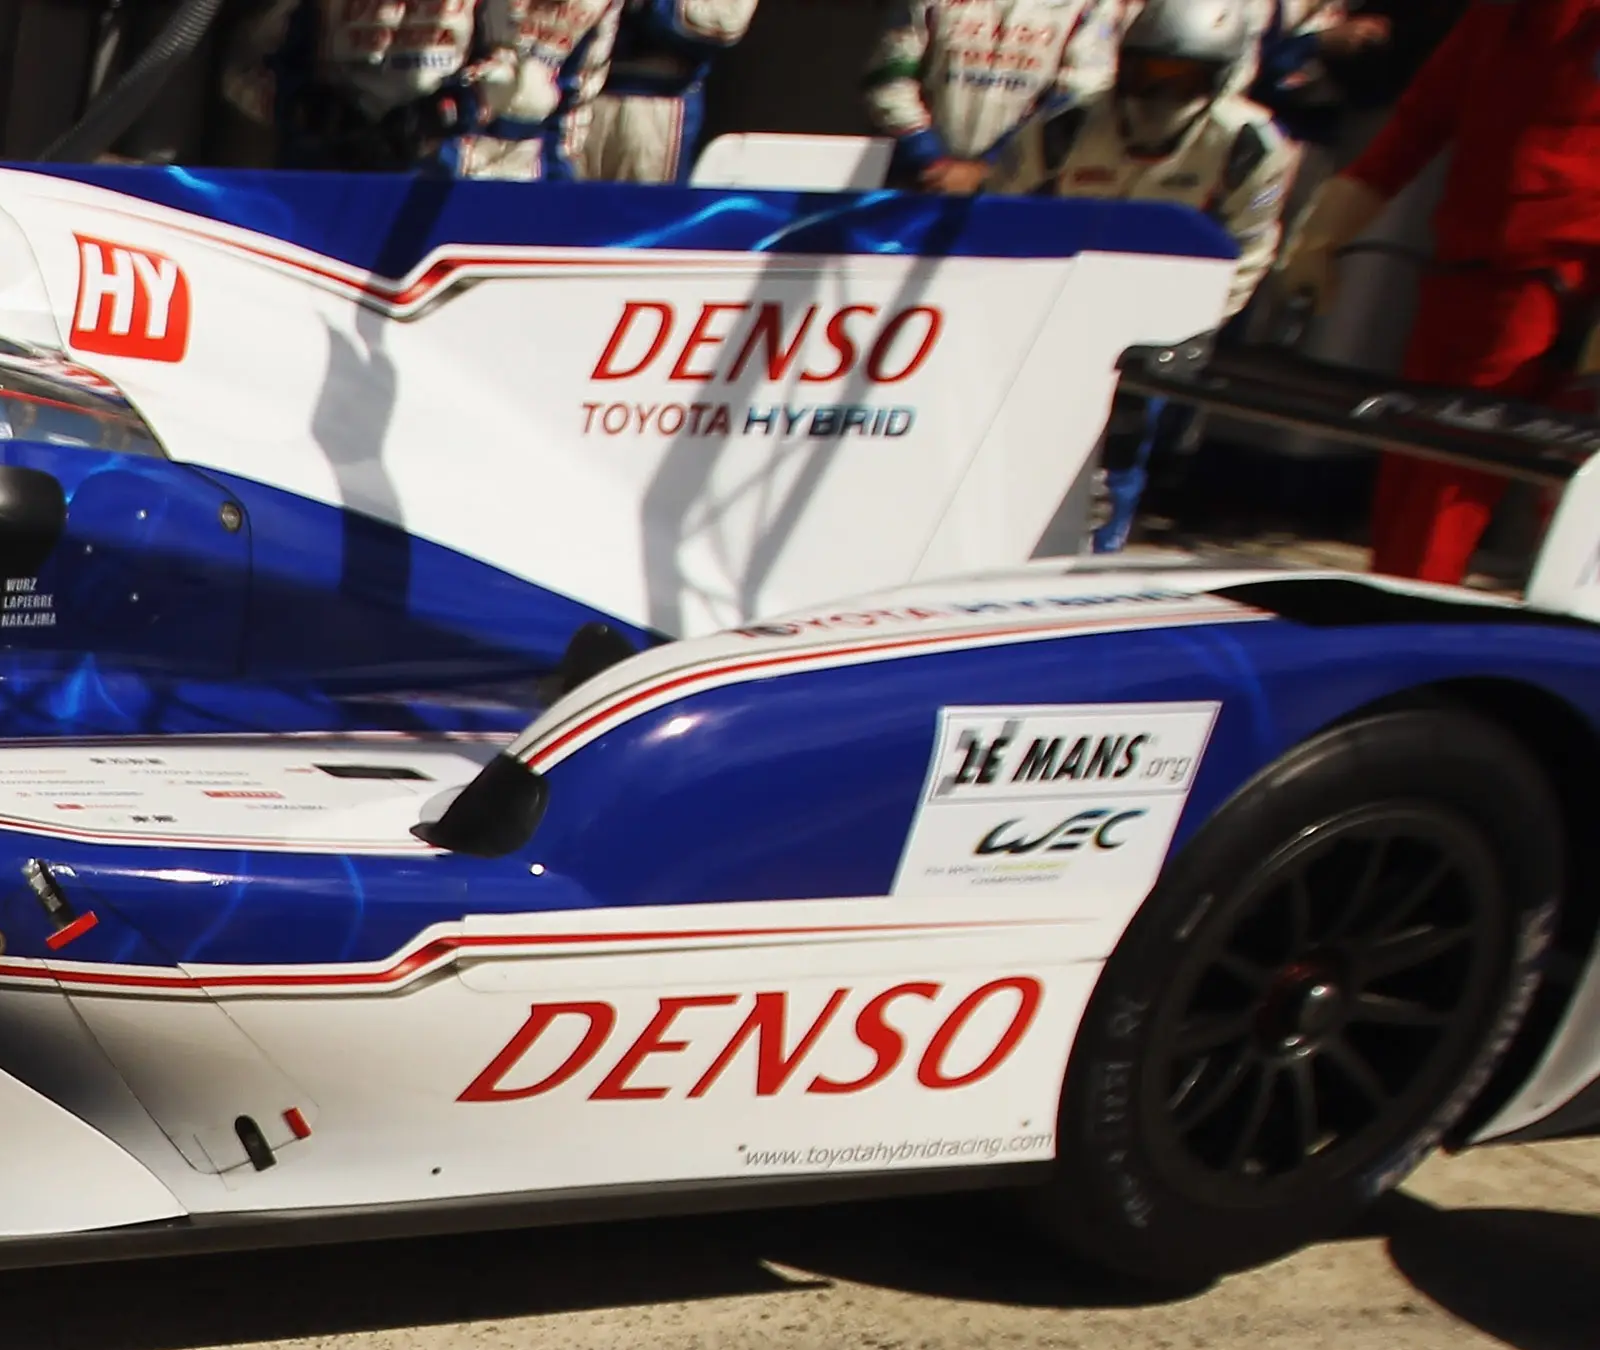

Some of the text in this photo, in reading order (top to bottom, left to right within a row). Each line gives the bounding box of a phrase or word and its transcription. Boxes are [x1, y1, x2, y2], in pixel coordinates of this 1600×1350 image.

[77, 238, 179, 338] HY
[591, 302, 944, 384] DENSO
[582, 403, 916, 437] TOYOTA HYBRID
[4, 594, 54, 609] LAPIERRE
[6, 578, 37, 591] WURZ
[1, 612, 56, 627] NAKAJIMA
[1011, 733, 1150, 782] MANS
[973, 809, 1150, 855] WEC
[457, 975, 1045, 1104] DENSO
[743, 1130, 1053, 1168] www.toyotahybridracing.com
